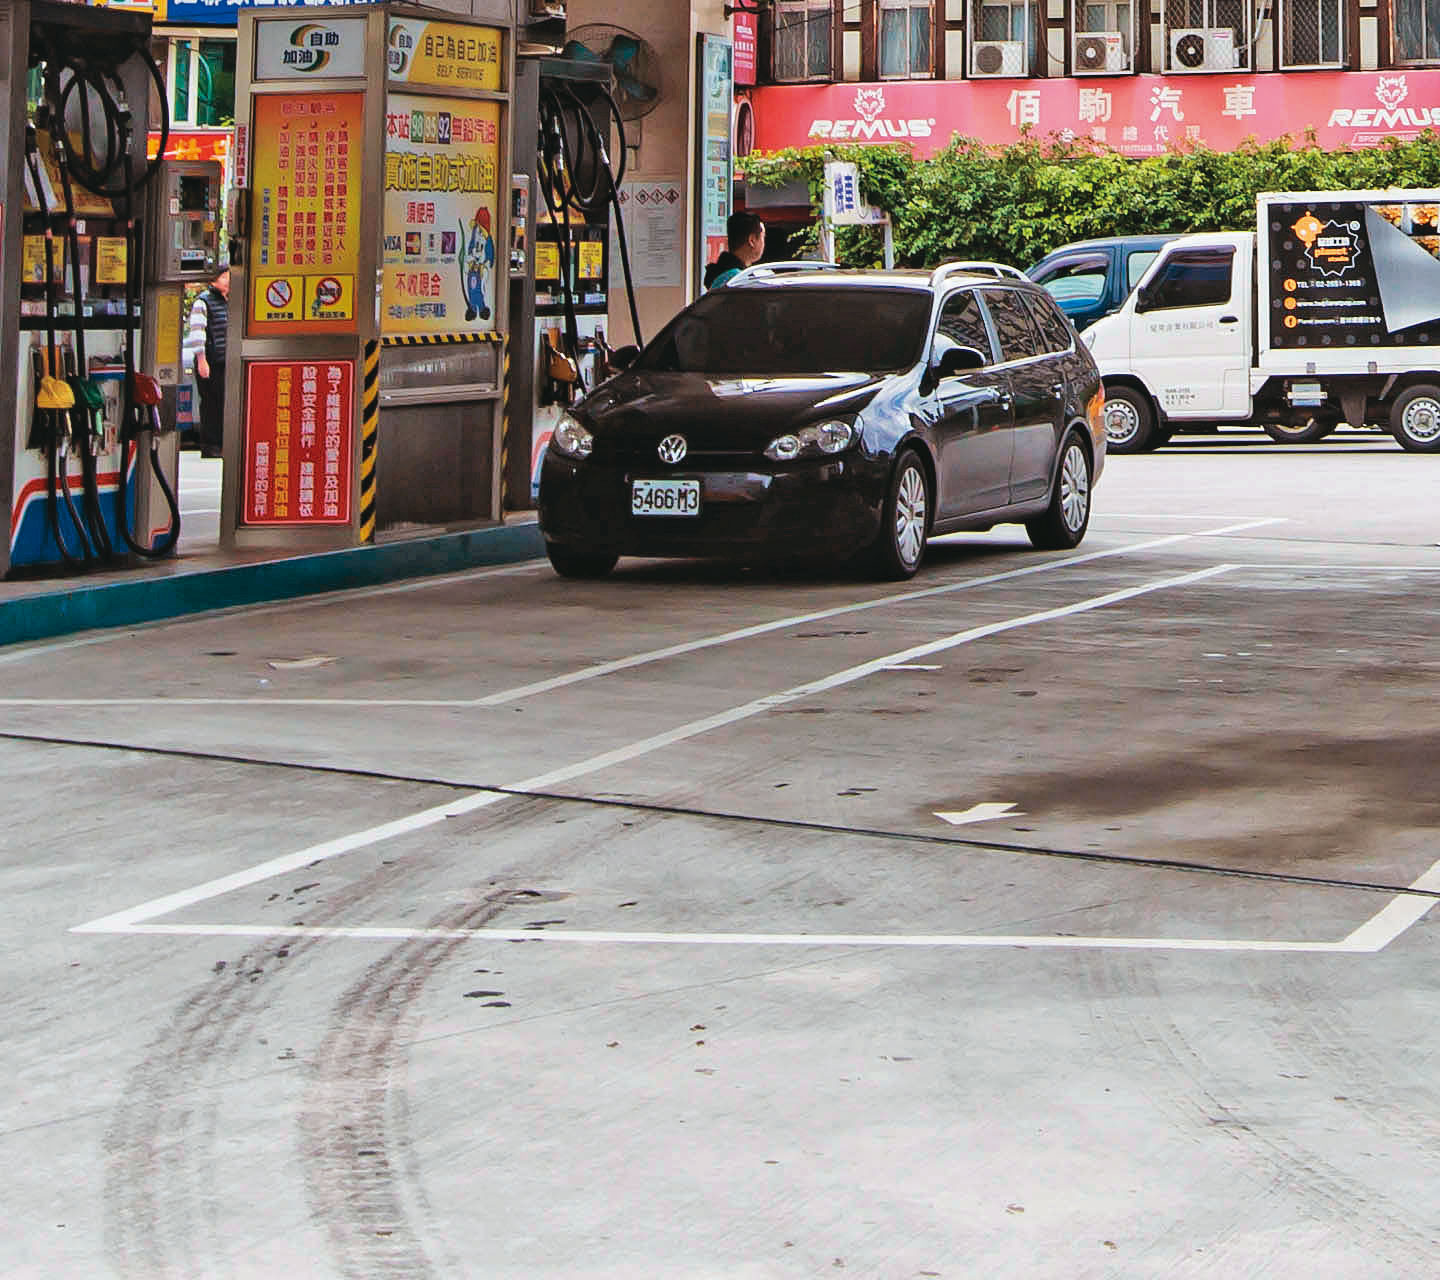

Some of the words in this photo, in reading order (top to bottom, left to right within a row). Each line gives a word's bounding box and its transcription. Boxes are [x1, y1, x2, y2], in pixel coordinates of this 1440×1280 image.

[309, 31, 339, 47] 自助
[282, 48, 313, 65] 加油
[1006, 84, 1257, 126] 佰駒汽車
[807, 118, 932, 140] REMUS
